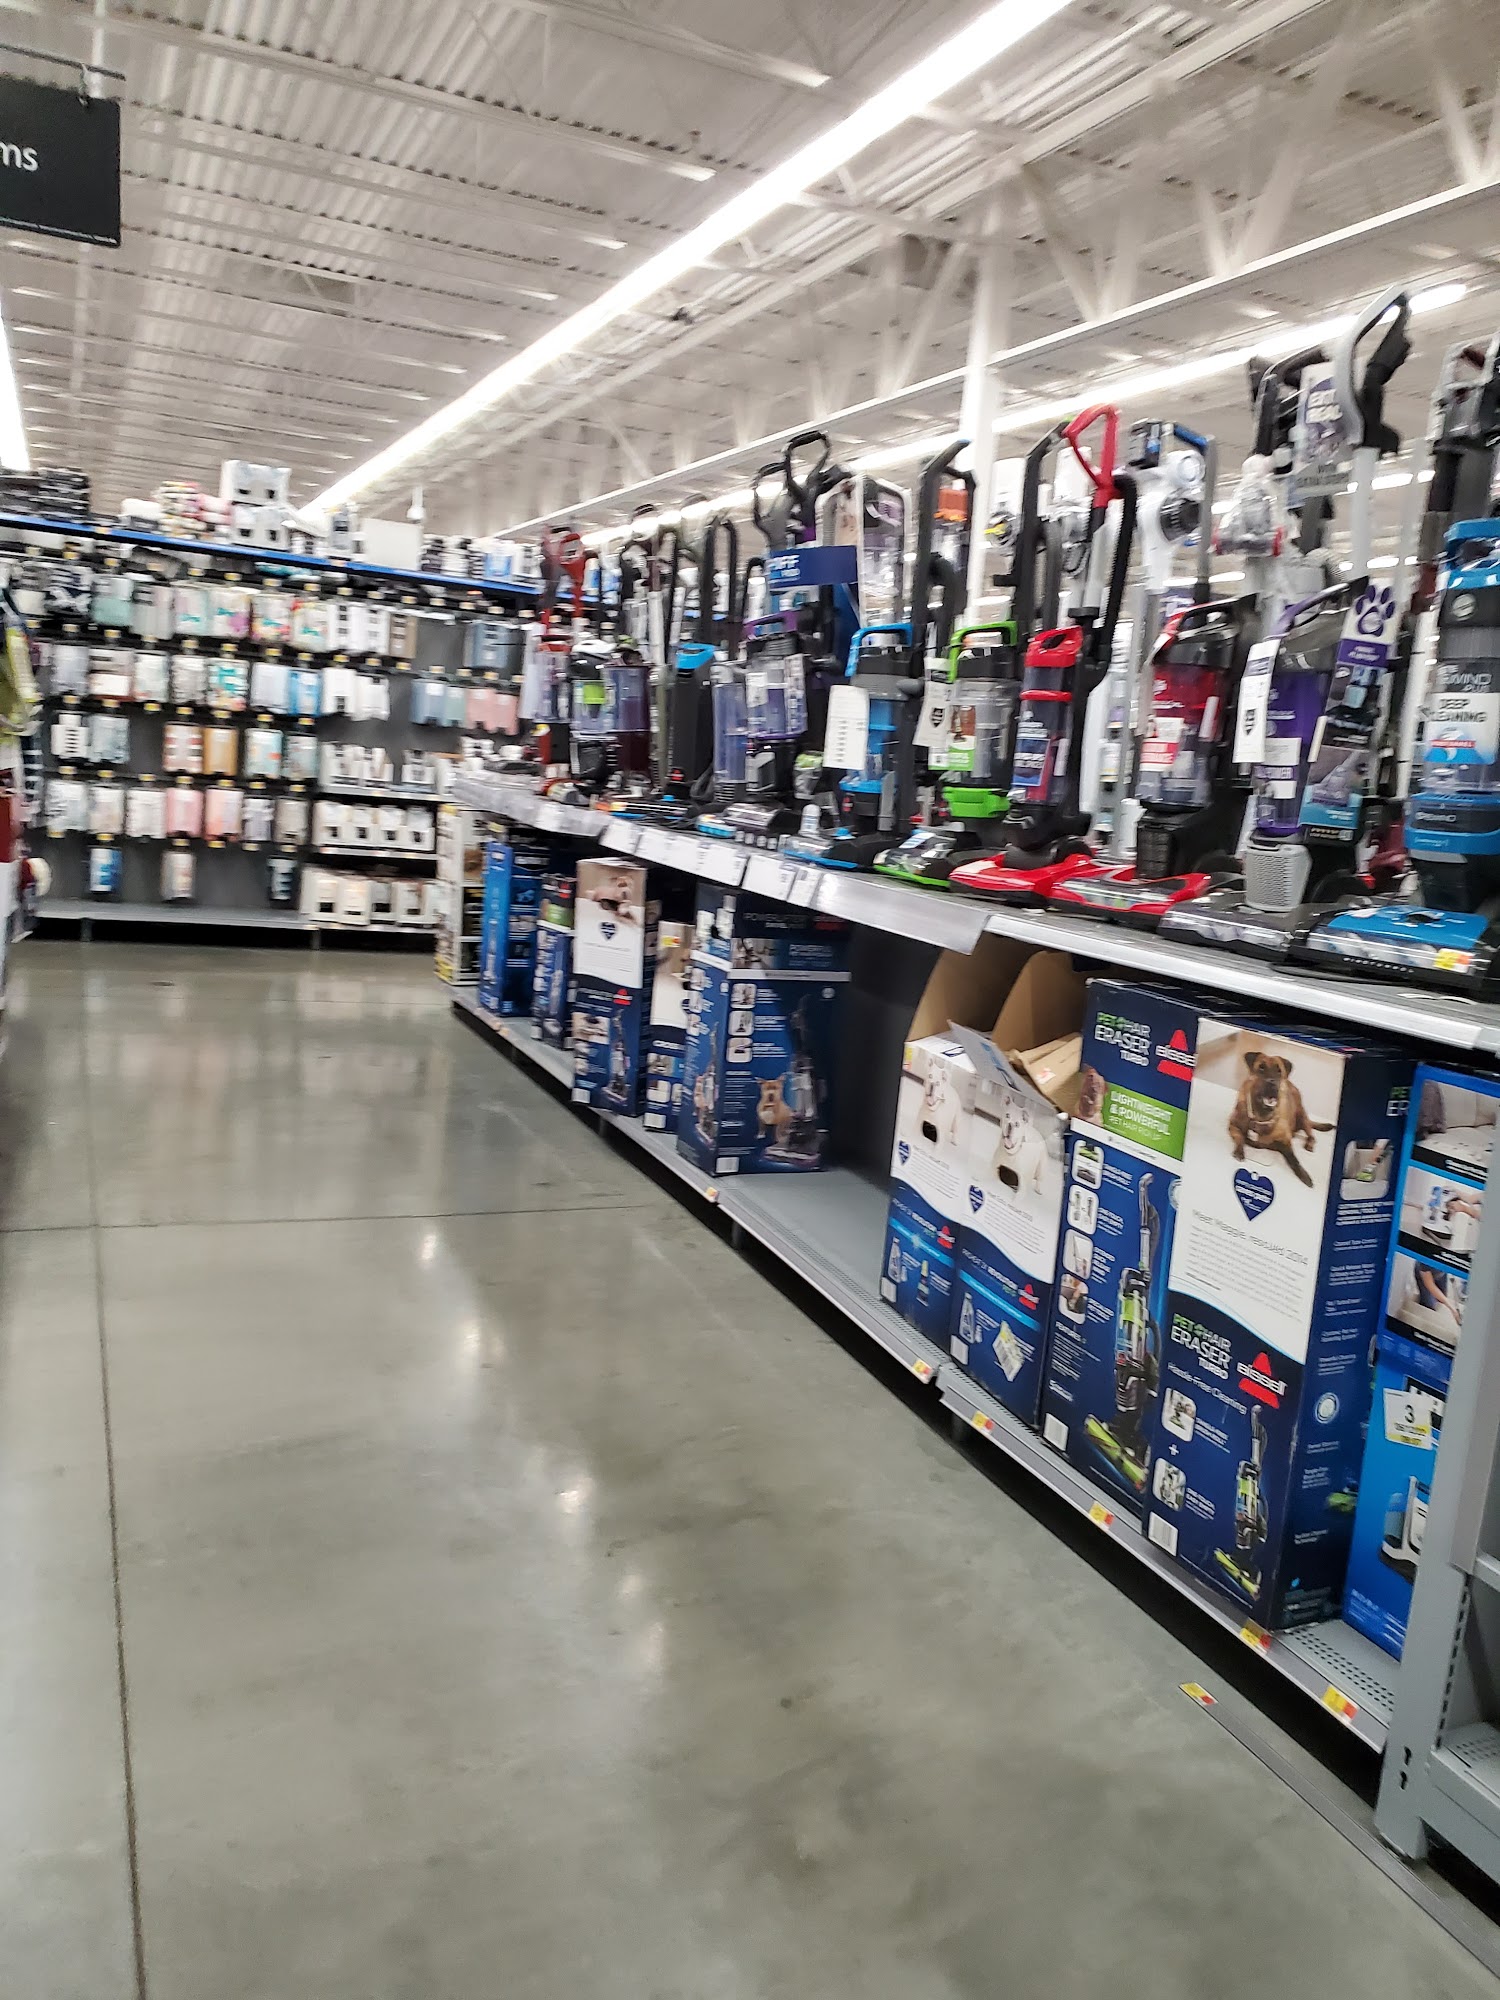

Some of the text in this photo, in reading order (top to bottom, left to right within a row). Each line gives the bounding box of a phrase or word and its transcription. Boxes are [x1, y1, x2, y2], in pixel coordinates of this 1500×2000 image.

[1094, 1024, 1151, 1056] ERASER
[1110, 1090, 1173, 1122] LIGHTWEIGHT
[1118, 1106, 1171, 1136] POWERFUL
[1170, 1325, 1231, 1370] ERASER
[1173, 1312, 1232, 1353] PET HAIR
[1197, 1356, 1229, 1380] TURBO
[1211, 1386, 1248, 1416] Cleaning
[1404, 1403, 1416, 1424] 3
